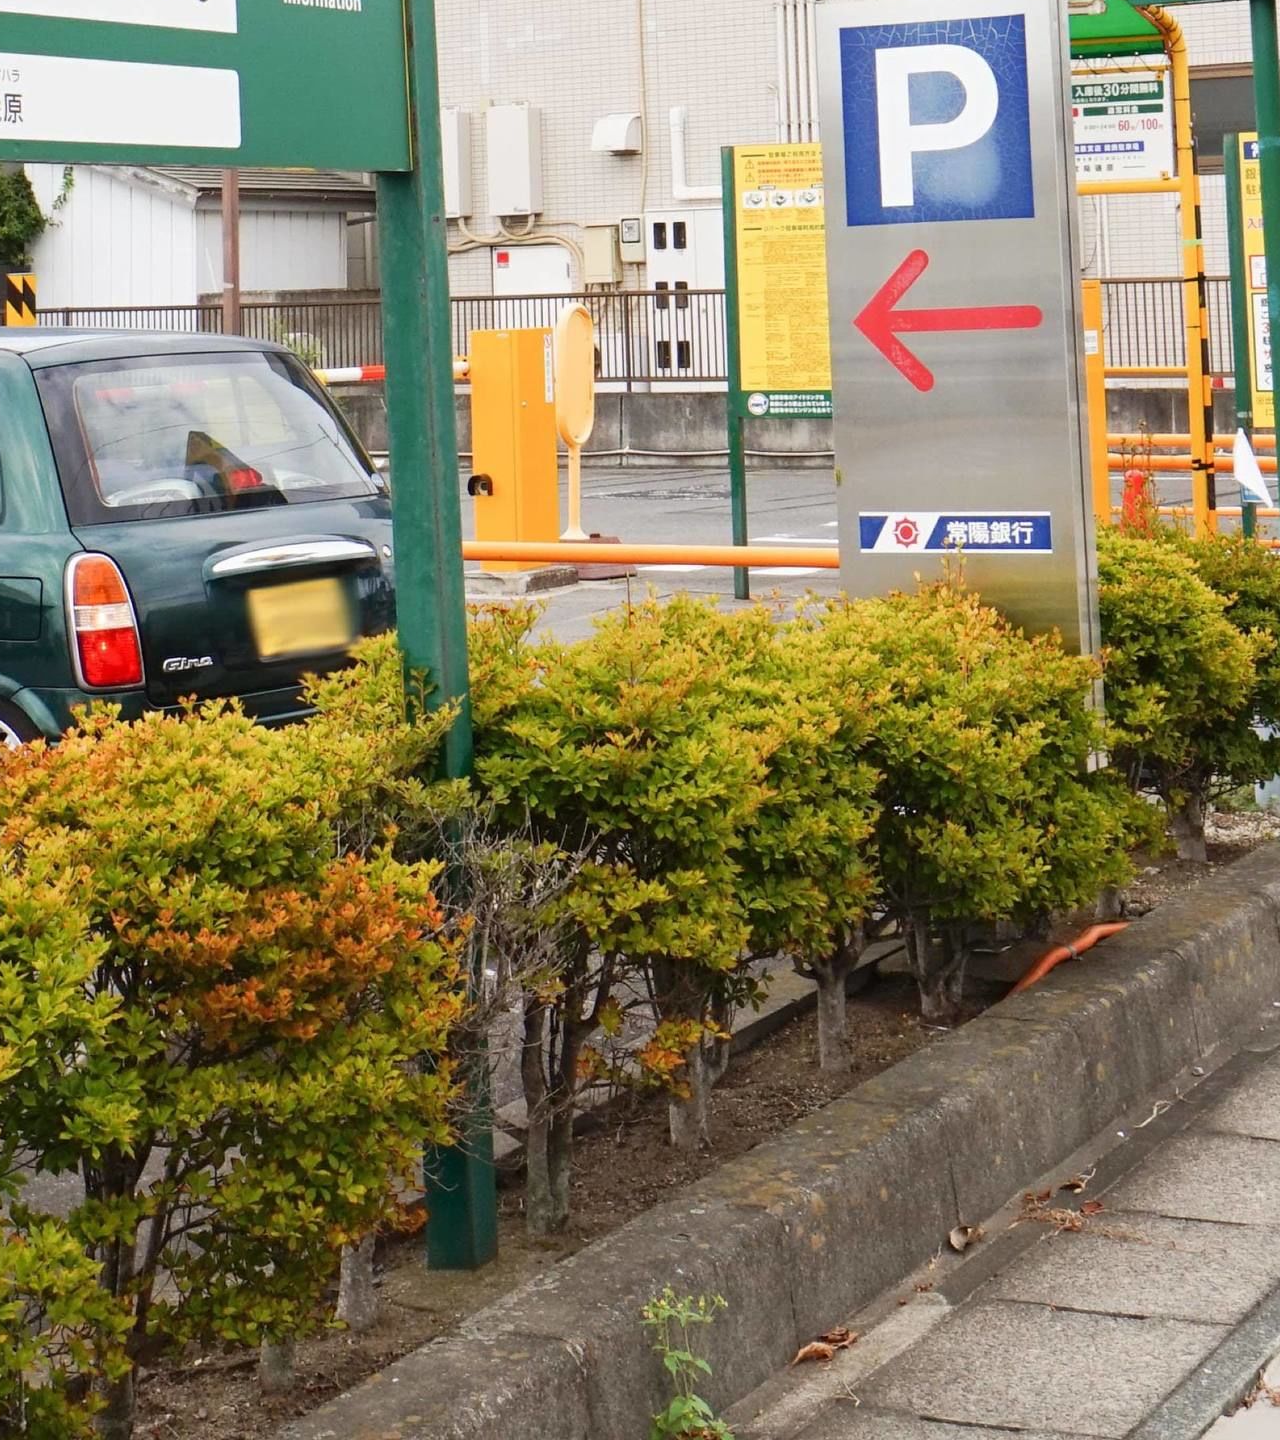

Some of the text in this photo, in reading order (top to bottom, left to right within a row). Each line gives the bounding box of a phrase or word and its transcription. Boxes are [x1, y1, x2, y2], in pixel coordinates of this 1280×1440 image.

[875, 43, 1000, 208] P
[946, 521, 1034, 545] 常陽銀行
